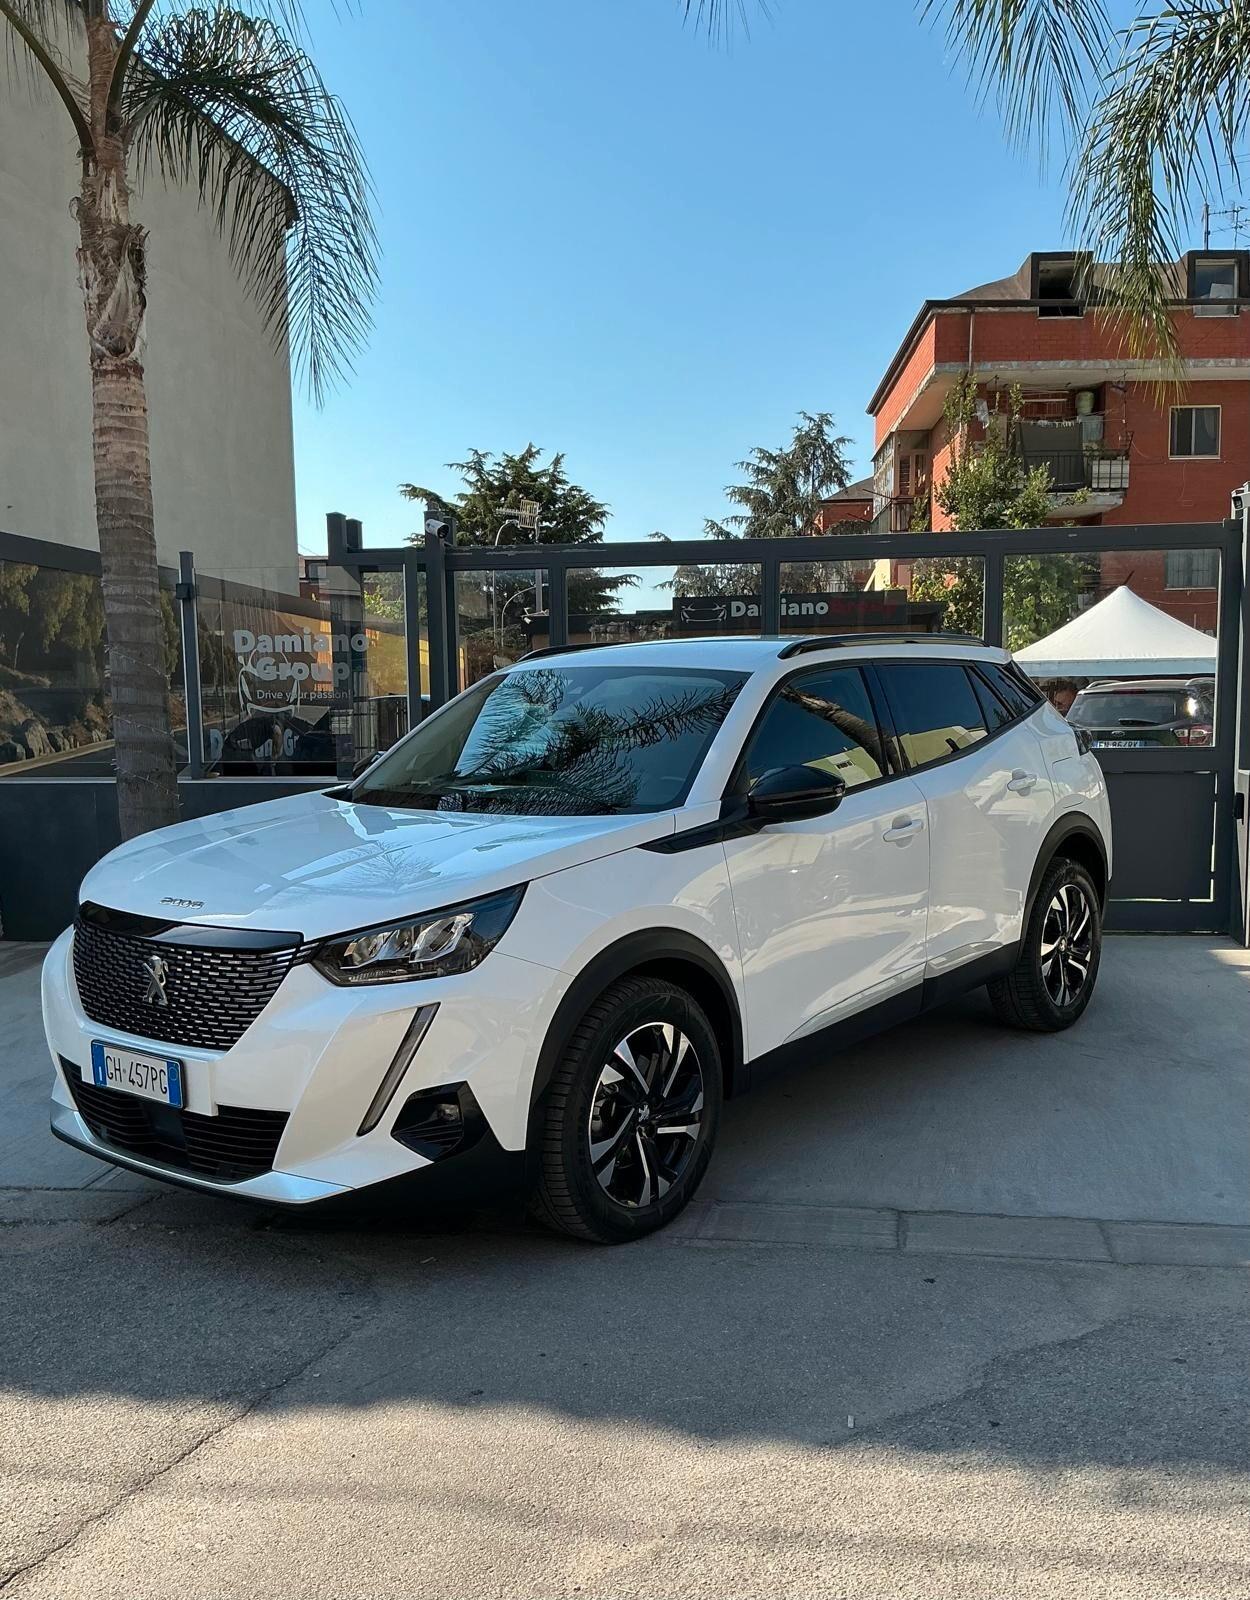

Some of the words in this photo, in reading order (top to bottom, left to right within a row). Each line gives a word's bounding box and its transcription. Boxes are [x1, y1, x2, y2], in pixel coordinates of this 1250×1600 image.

[731, 598, 829, 617] Daiano
[233, 626, 369, 653] Damiano
[256, 657, 350, 687] Group
[257, 689, 286, 699] Drive
